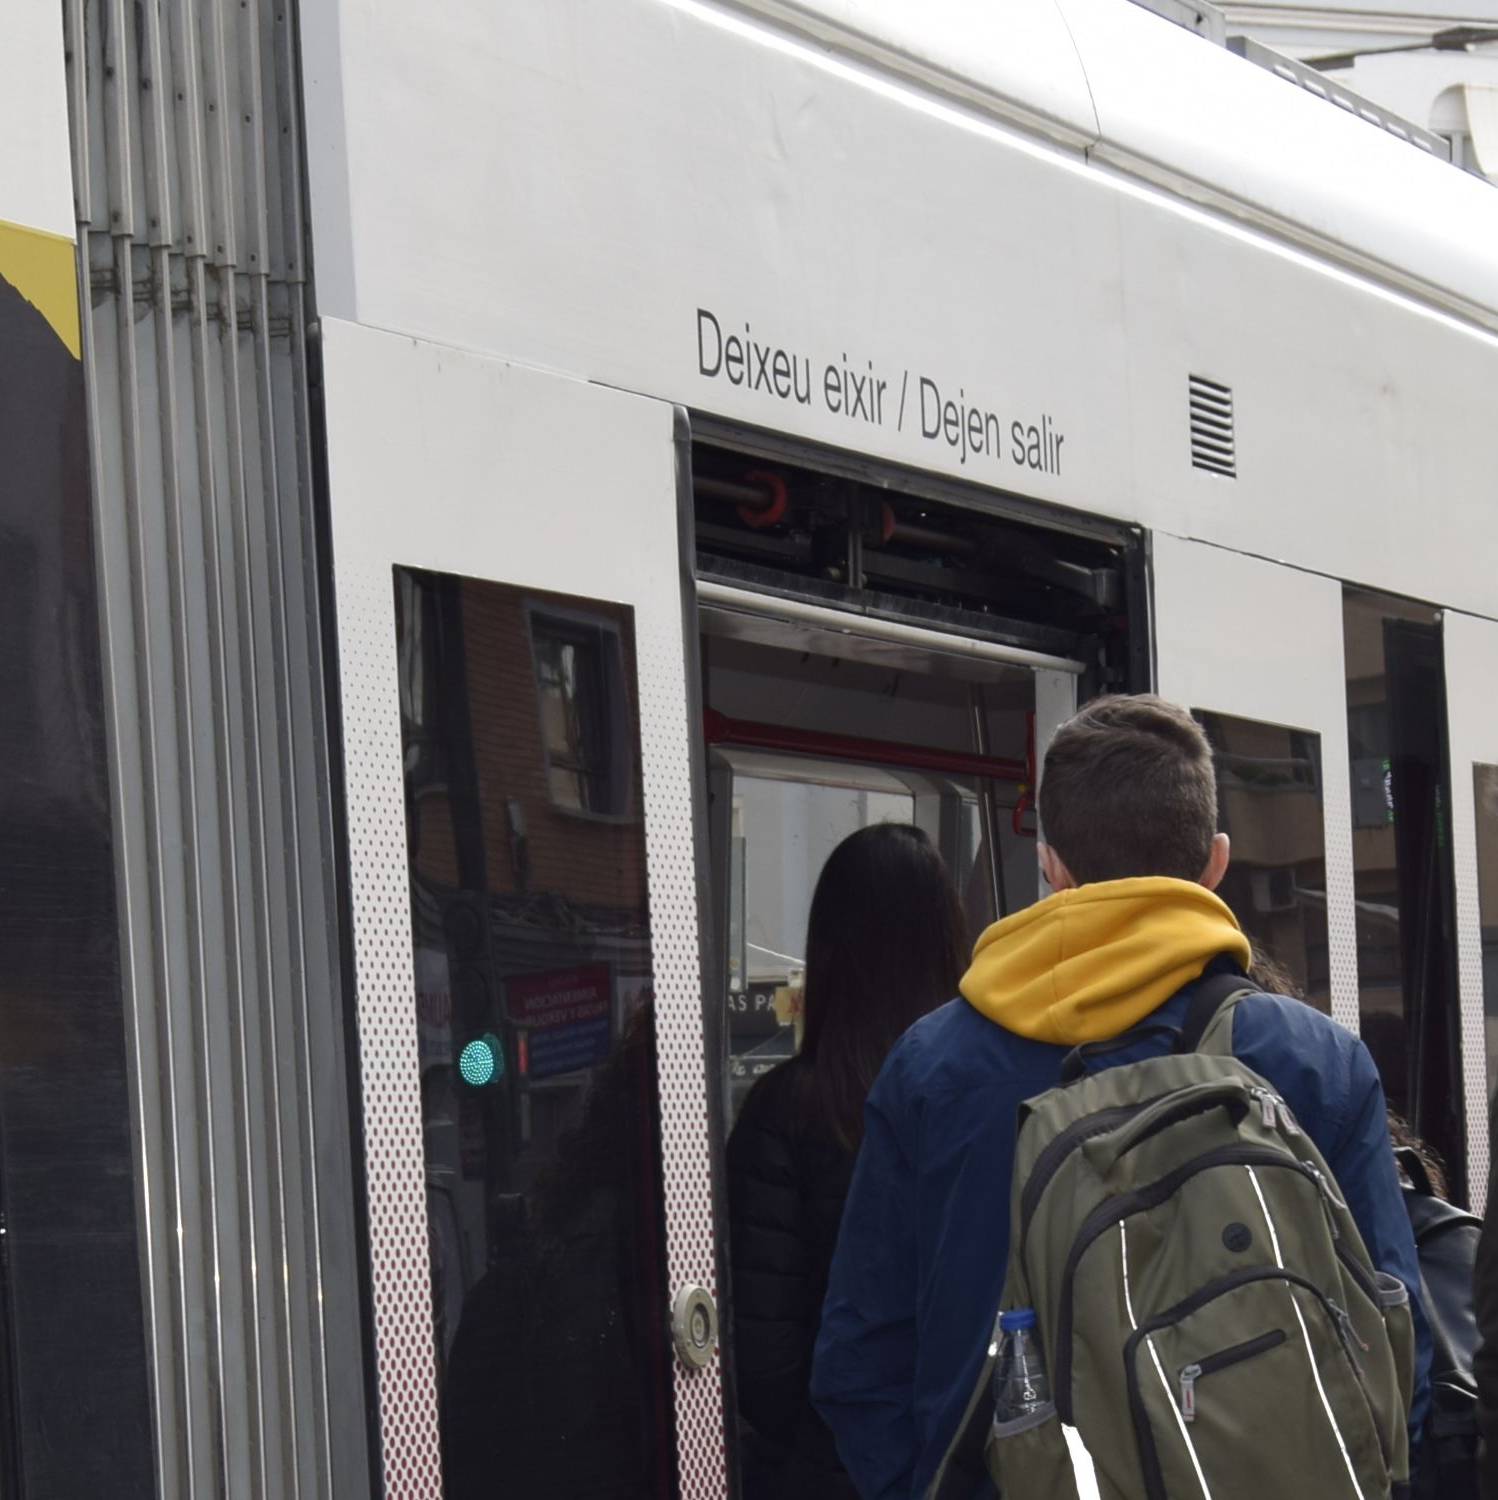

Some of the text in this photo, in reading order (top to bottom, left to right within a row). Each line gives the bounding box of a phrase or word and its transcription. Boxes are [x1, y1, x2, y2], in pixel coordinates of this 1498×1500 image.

[696, 306, 1065, 477] Deixeu eixir / Dejen salir
